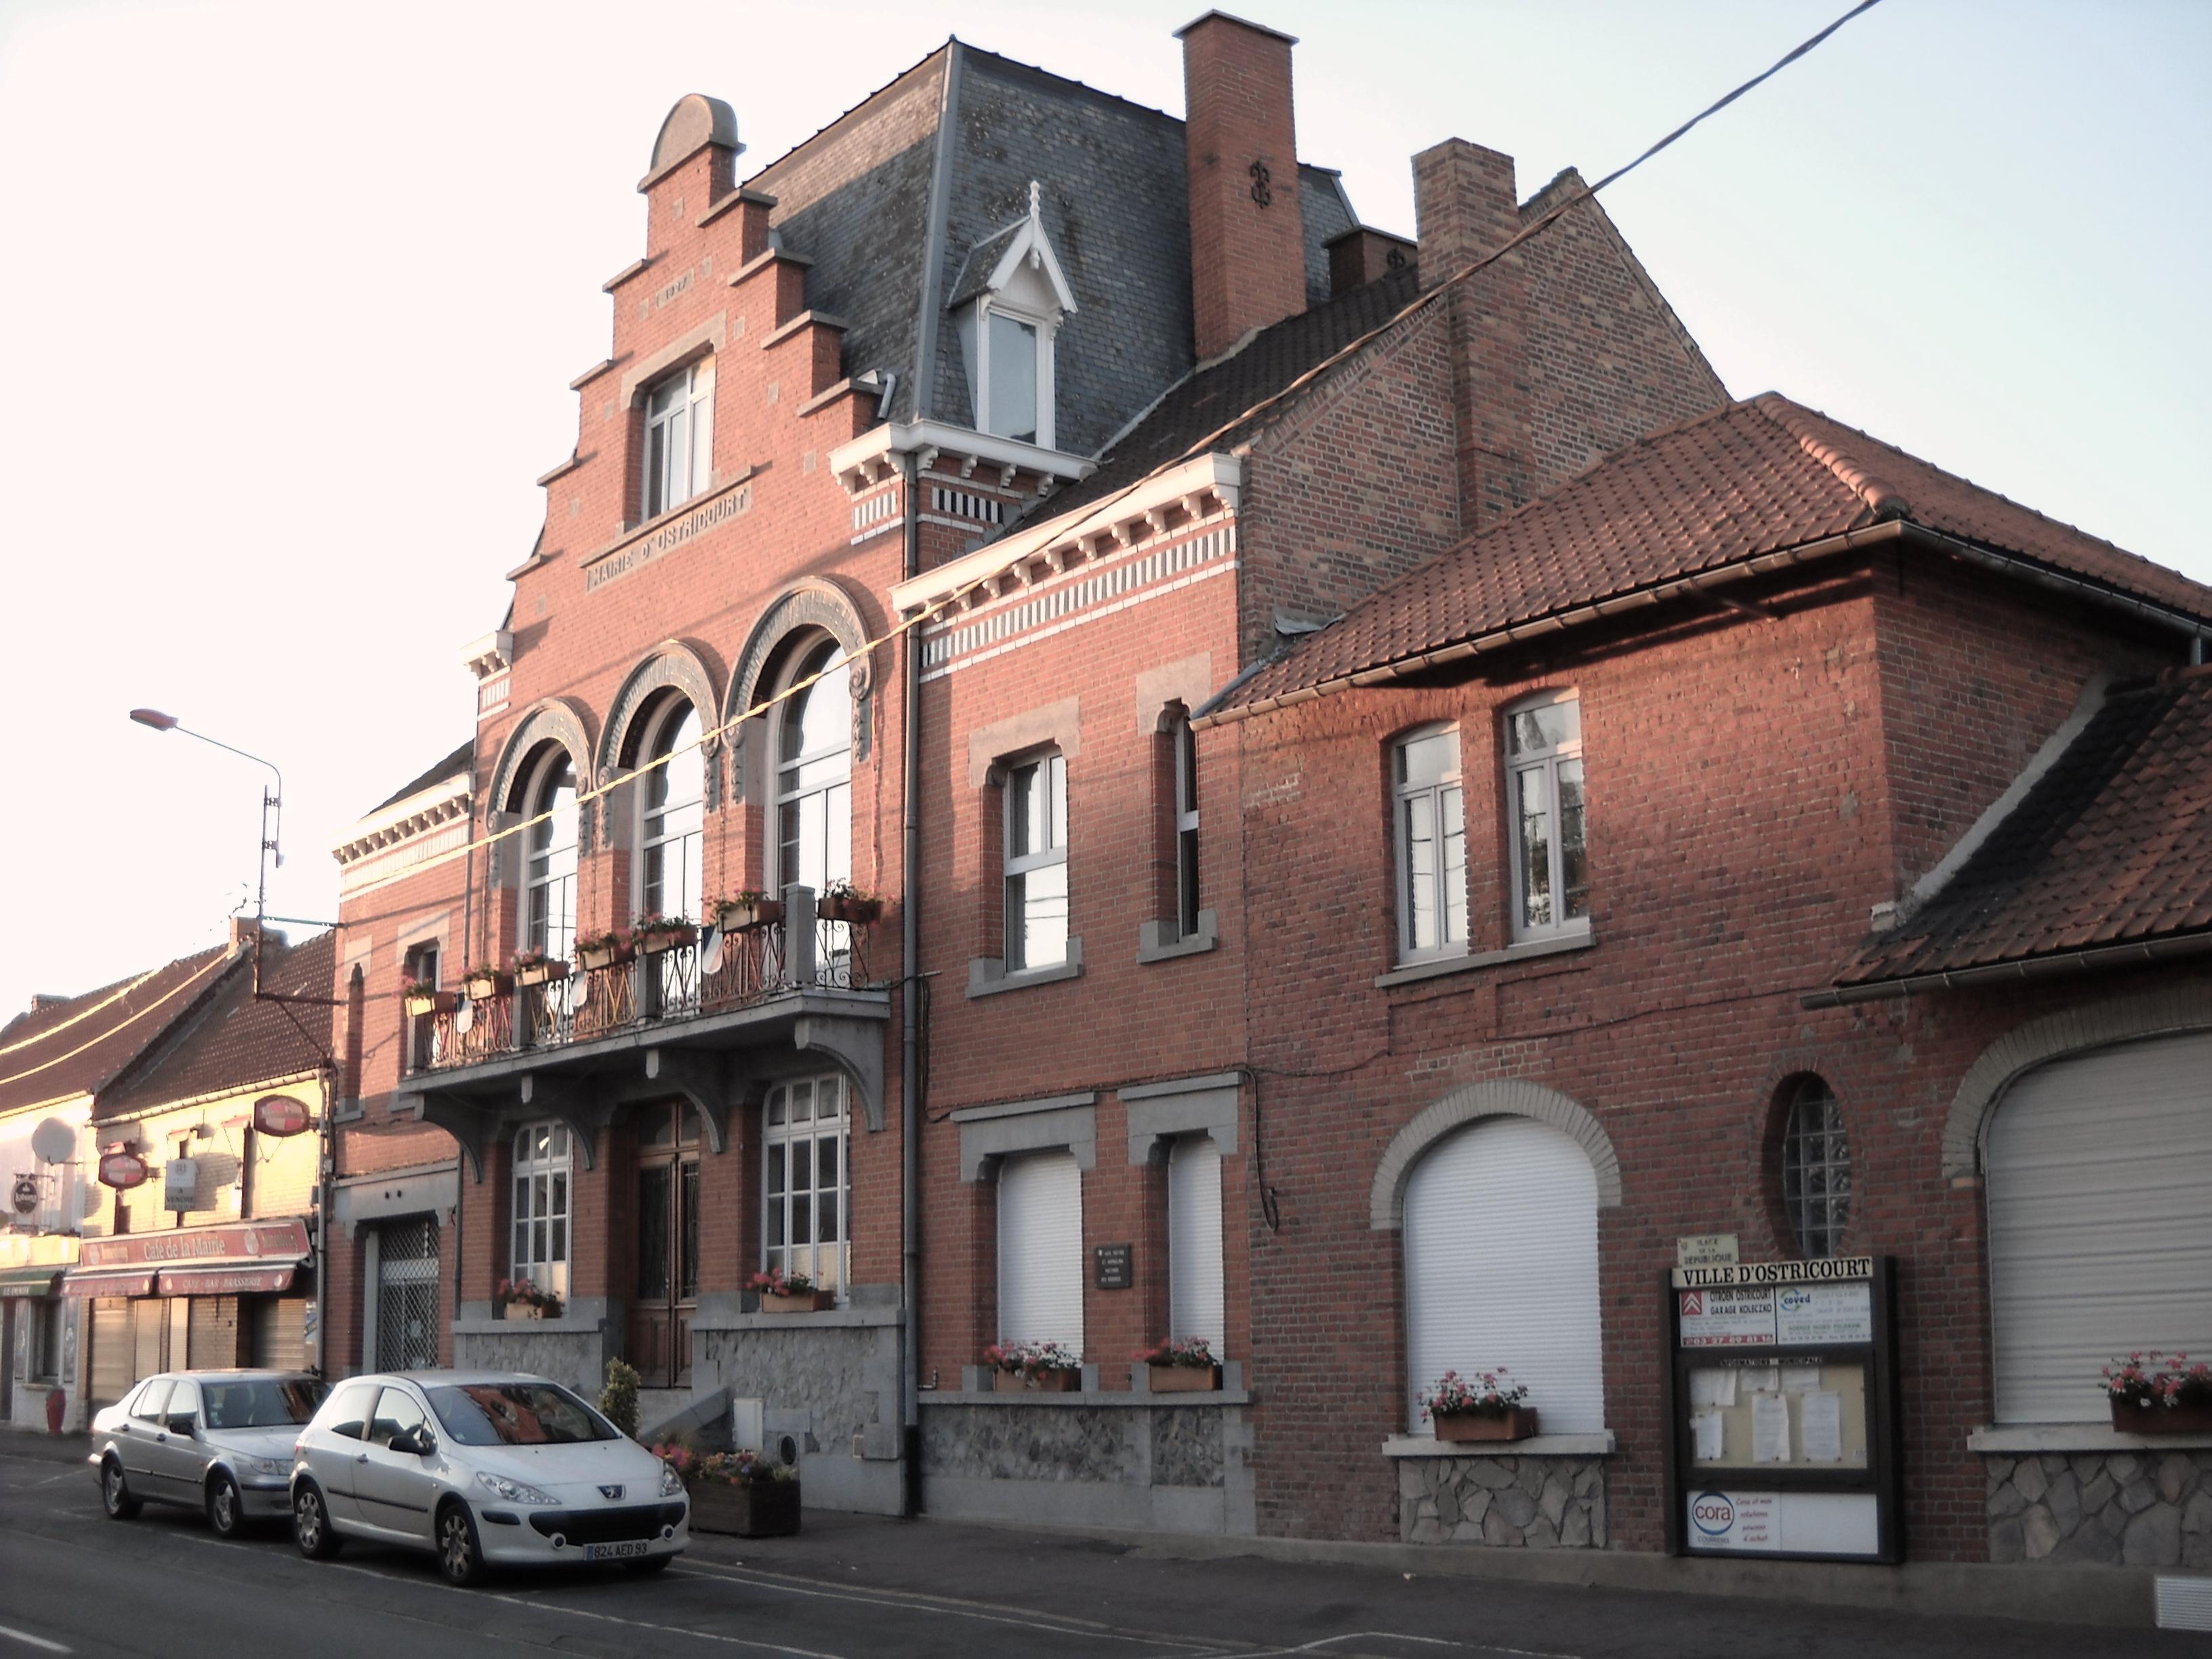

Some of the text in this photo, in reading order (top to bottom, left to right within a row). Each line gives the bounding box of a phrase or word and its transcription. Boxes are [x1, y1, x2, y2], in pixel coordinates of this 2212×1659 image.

[143, 1239, 165, 1261] Café
[167, 1238, 178, 1258] de
[180, 1237, 191, 1257] la
[193, 1236, 226, 1256] Mairie
[1683, 1258, 1870, 1286] VILLE D'OSTRICOURT
[223, 1277, 262, 1287] BRASSERIE
[1736, 1288, 1771, 1300] OSTRICOURT
[1784, 1293, 1811, 1305] coved
[1710, 1304, 1772, 1315] GARAGE KOLECZKO
[1695, 1506, 1731, 1521] cora
[594, 1542, 648, 1558] 824 AED 93
